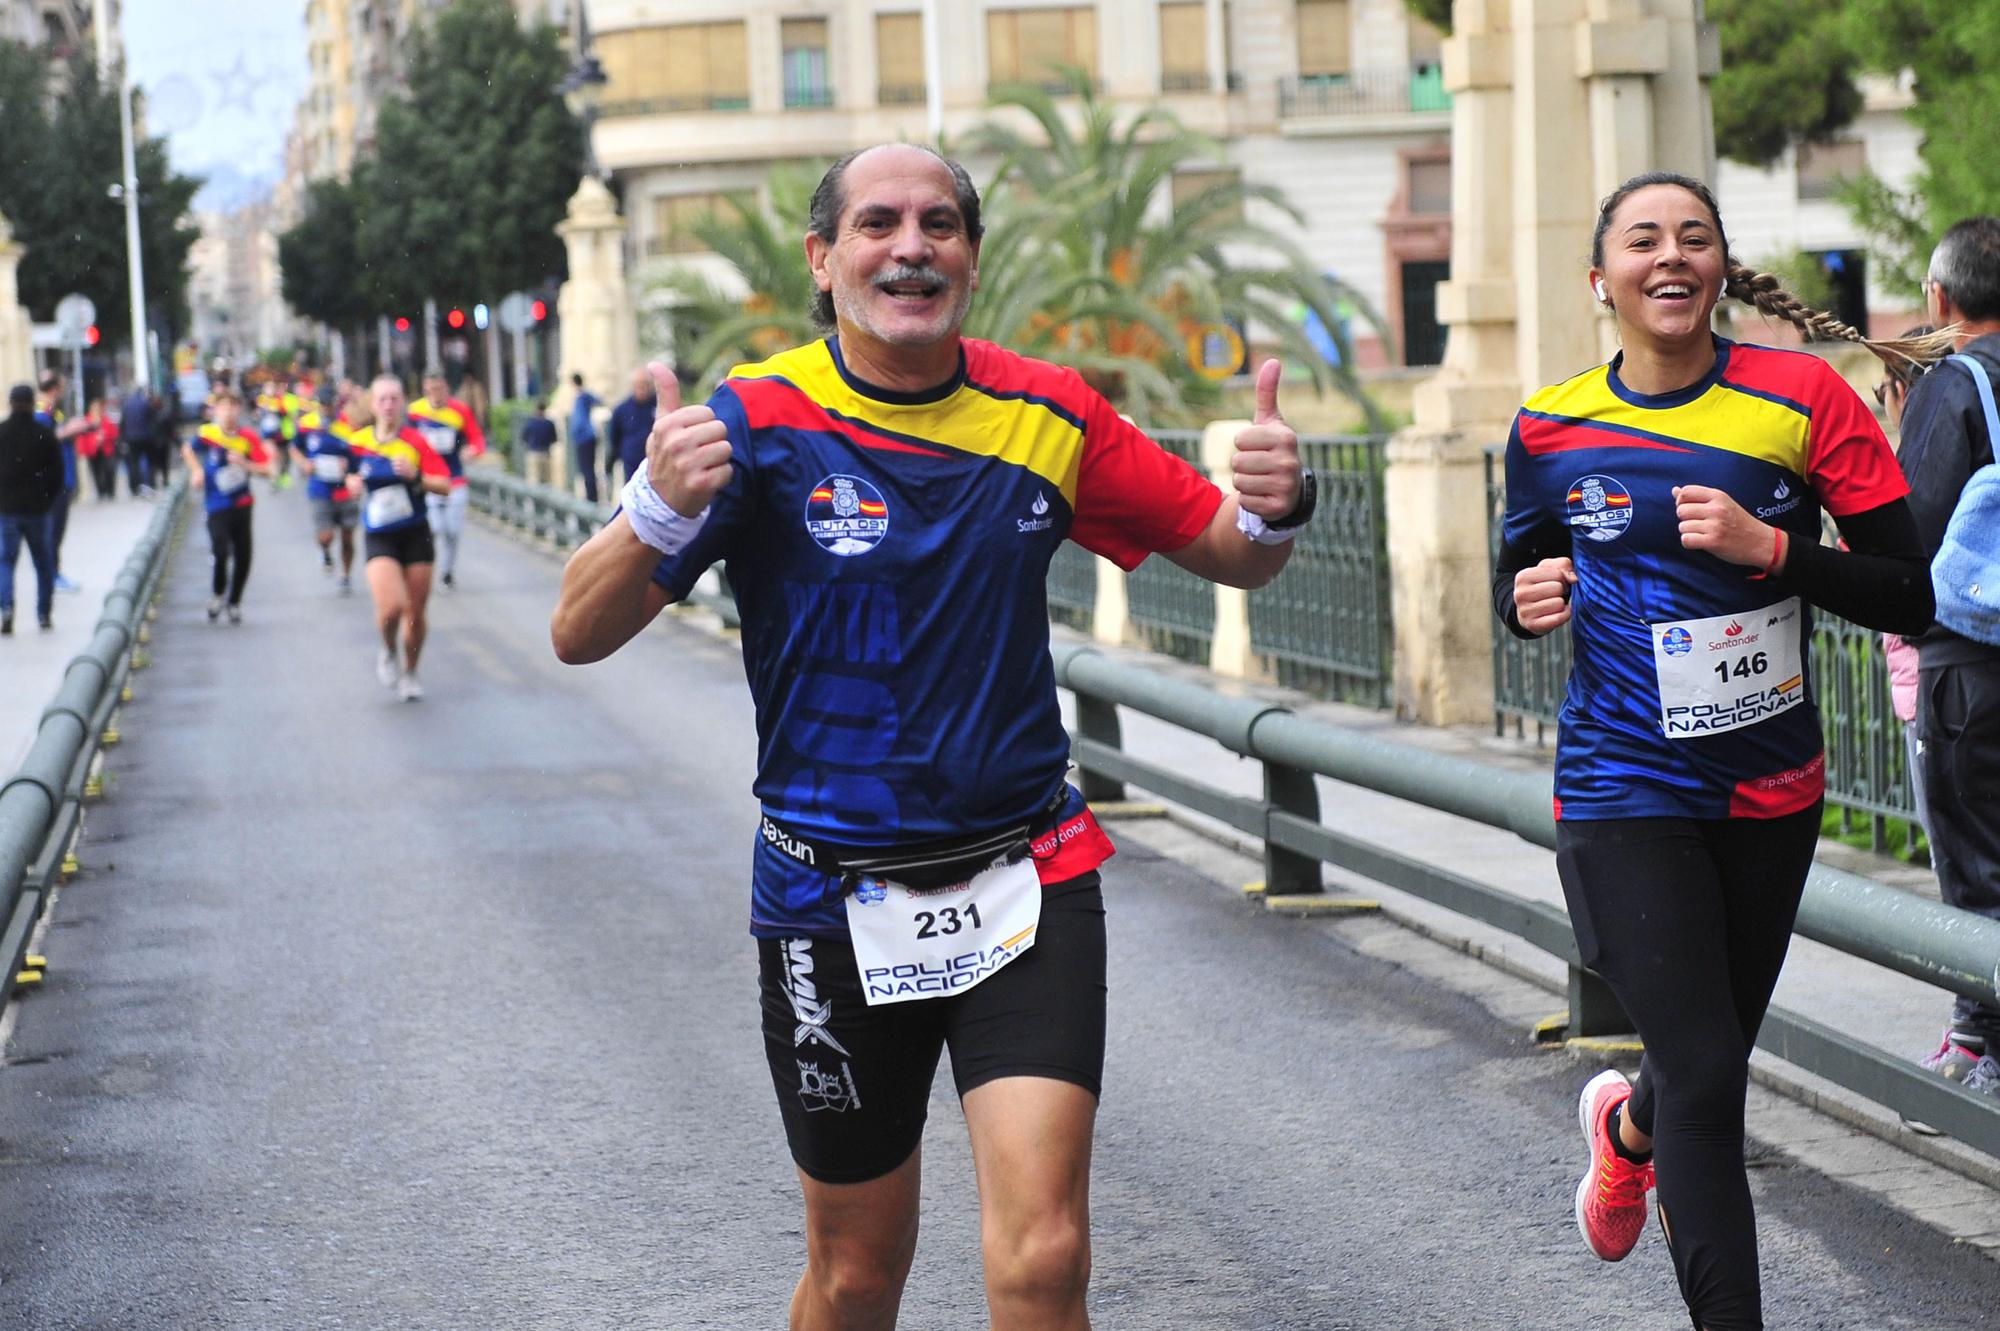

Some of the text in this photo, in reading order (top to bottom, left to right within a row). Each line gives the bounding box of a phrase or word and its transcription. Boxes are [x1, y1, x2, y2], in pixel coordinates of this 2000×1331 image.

[810, 519, 886, 533] RUTA 091
[1707, 633, 1760, 652] Santander
[1714, 651, 1768, 684] 146
[1666, 686, 1781, 719] POLICIA
[1668, 692, 1803, 733] NACIONAL
[762, 816, 815, 866] saxun
[914, 902, 982, 940] 231
[864, 945, 1006, 983] POLICIA
[868, 939, 1034, 998] NACIONAL
